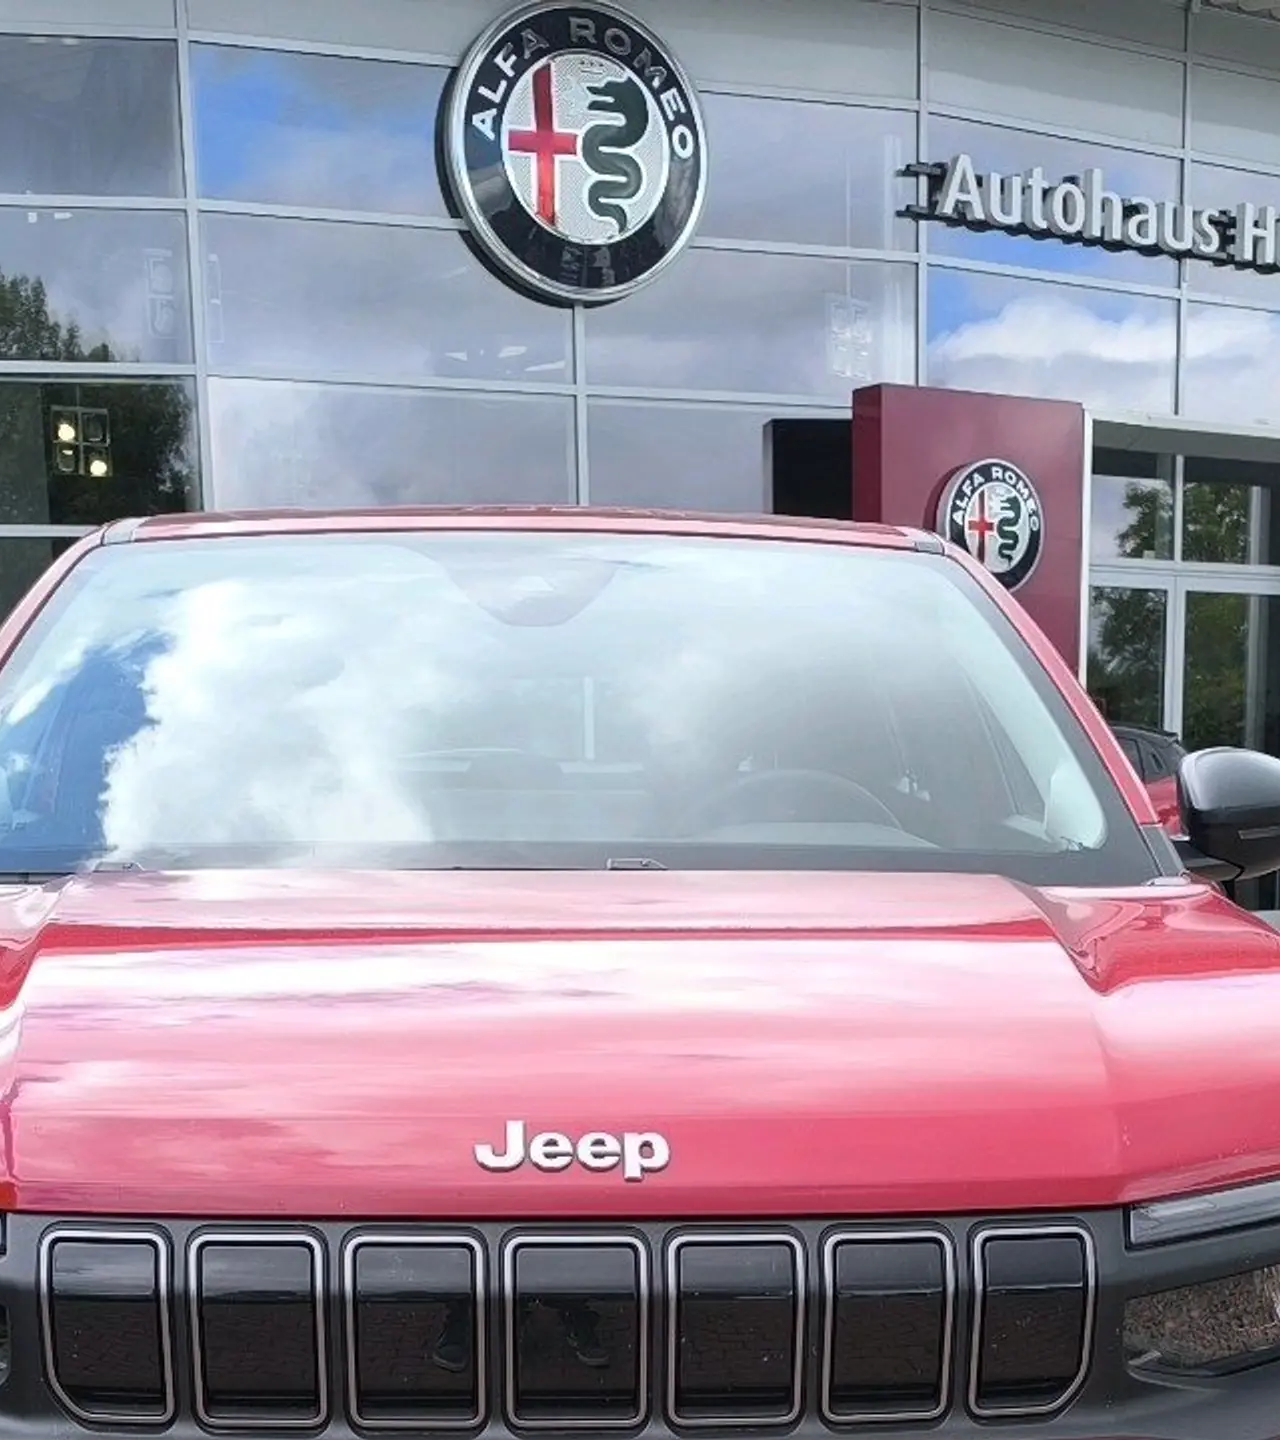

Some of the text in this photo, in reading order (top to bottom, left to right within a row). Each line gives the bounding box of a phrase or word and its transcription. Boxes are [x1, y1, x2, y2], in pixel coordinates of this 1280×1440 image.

[472, 16, 694, 159] ALFA ROMEO
[935, 152, 1220, 256] Autohaus
[952, 466, 1039, 531] ALFA ROMEO
[474, 1120, 671, 1181] Jeep
